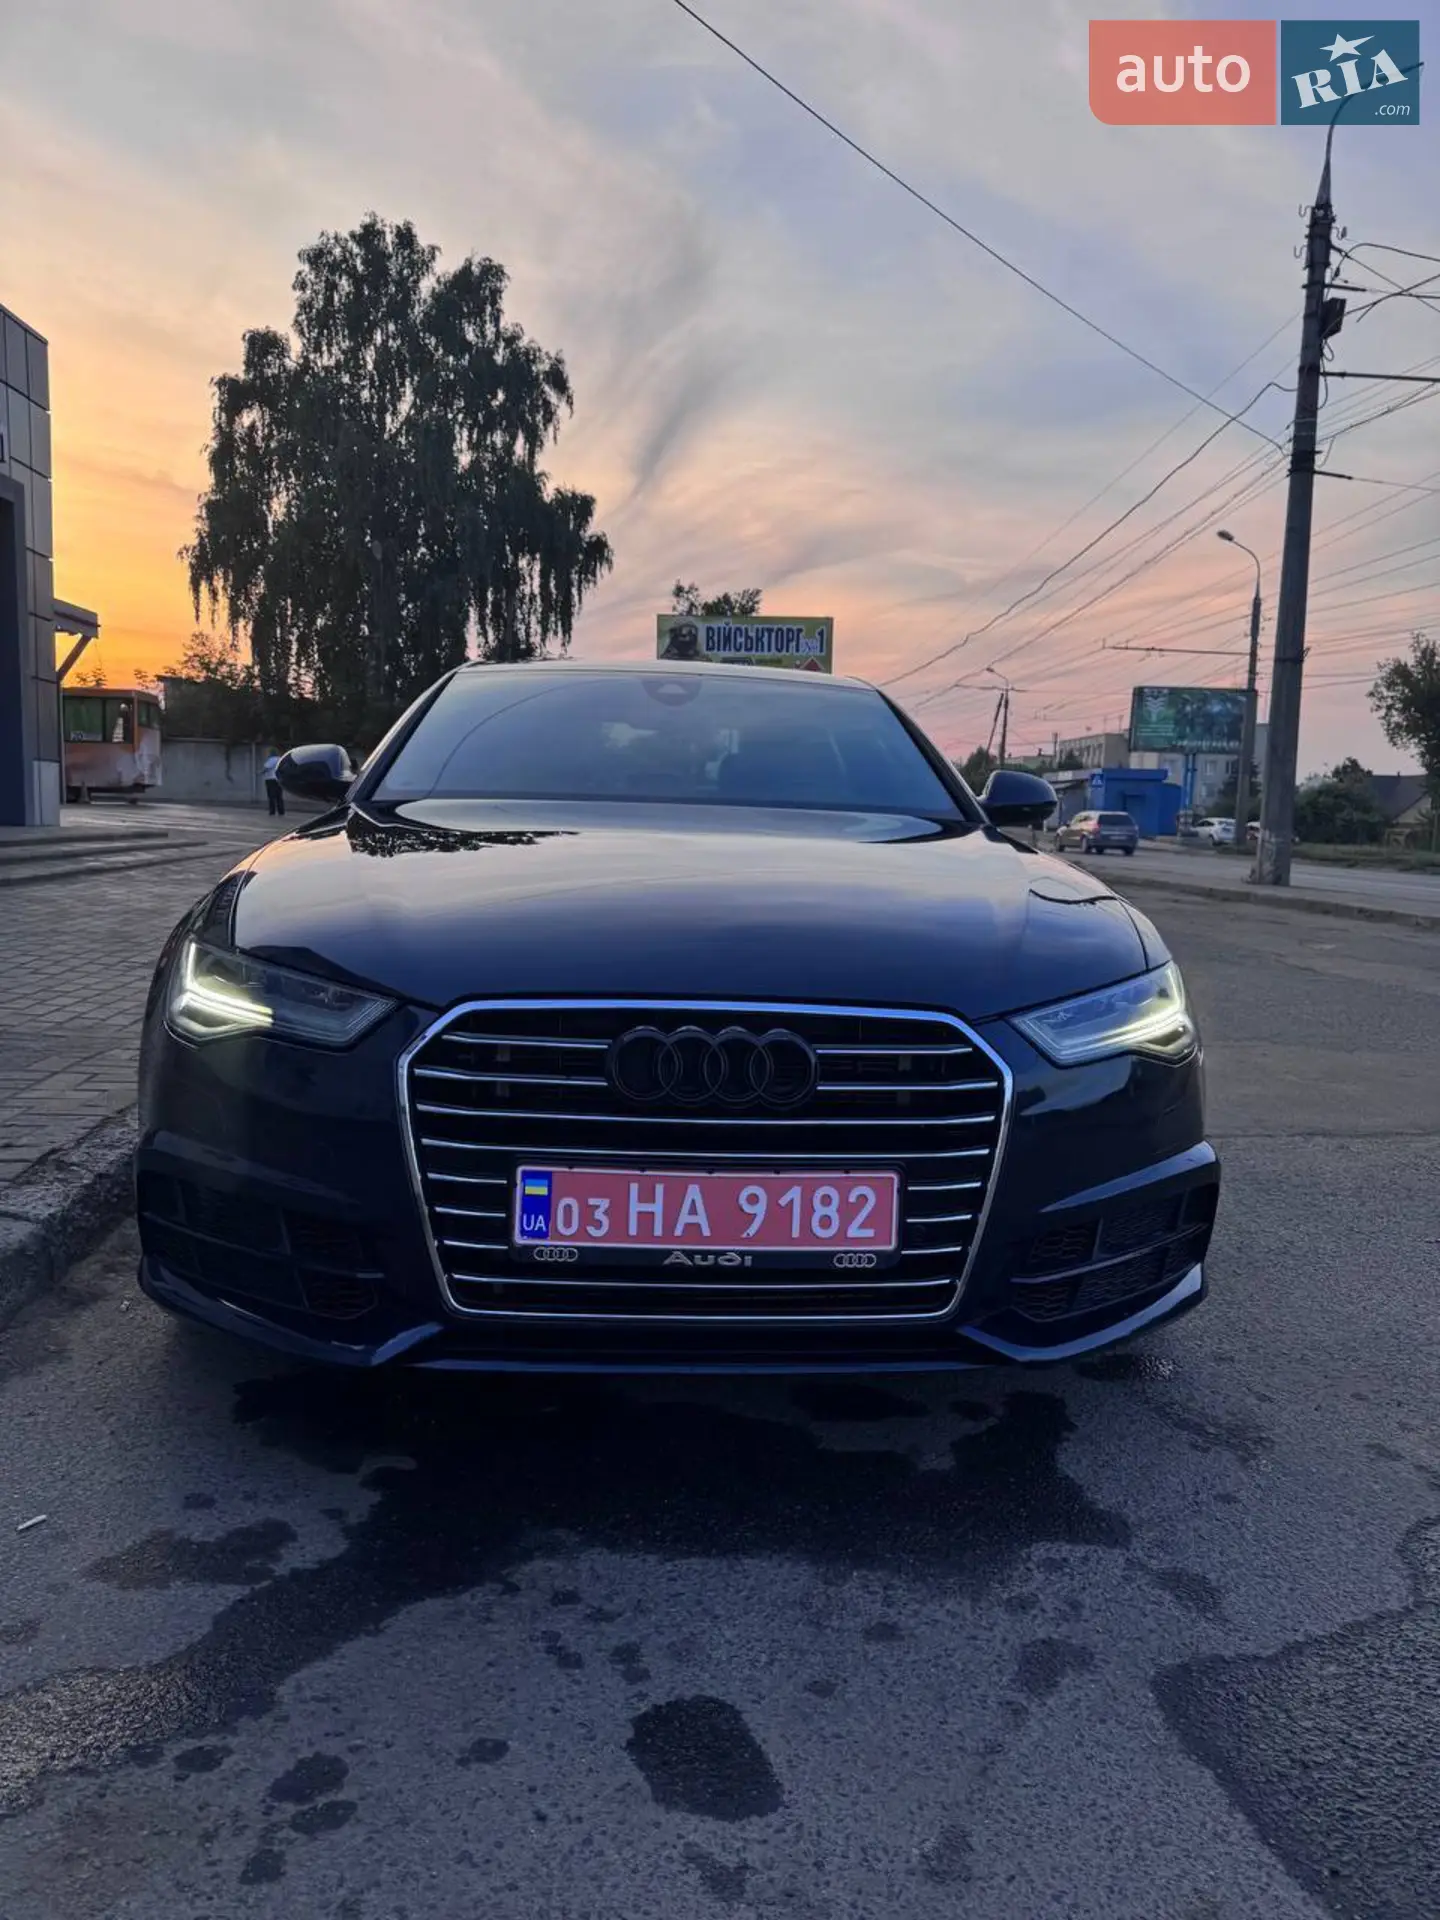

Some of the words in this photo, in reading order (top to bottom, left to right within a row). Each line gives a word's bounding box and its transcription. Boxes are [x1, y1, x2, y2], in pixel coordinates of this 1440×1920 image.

[705, 621, 803, 654] ВІЙСЬКТОРГ
[522, 1214, 547, 1231] UA
[556, 1197, 610, 1237] 03
[628, 1182, 711, 1238] HA
[738, 1184, 876, 1239] 9182
[662, 1248, 753, 1268] Audi
